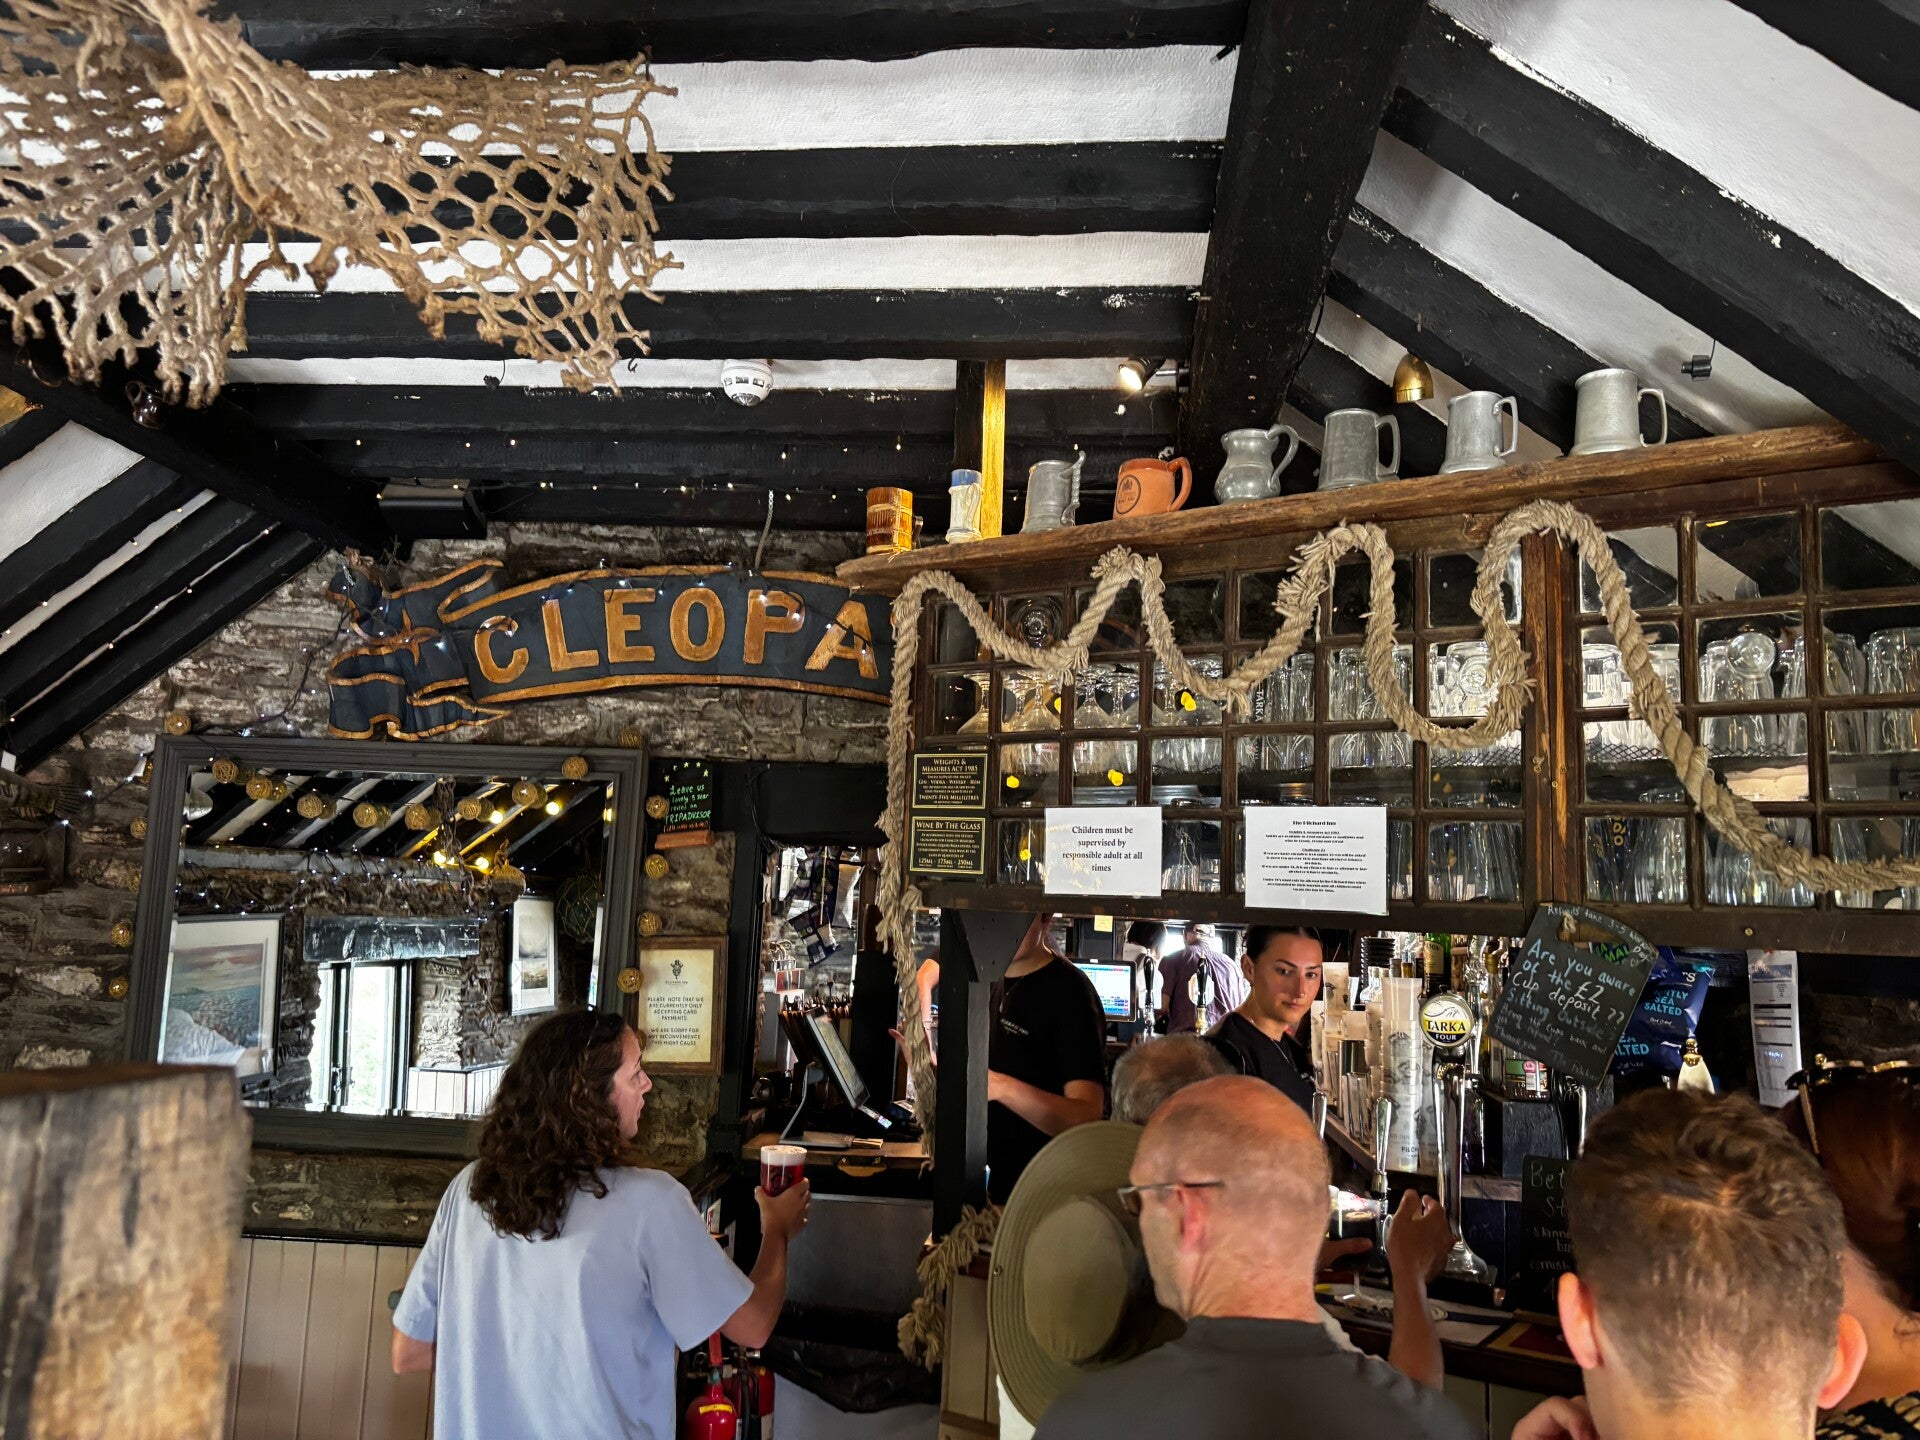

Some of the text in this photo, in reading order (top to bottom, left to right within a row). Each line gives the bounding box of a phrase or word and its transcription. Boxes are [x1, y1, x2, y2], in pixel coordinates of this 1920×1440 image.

[474, 587, 880, 684] CLEOPA
[670, 784, 705, 796] Leave us
[665, 810, 712, 824] TRIPADVISOR
[916, 821, 981, 830] WINE BY THE GLASS
[1072, 826, 1134, 834] Children must be
[1078, 839, 1127, 848] supervised by
[1062, 852, 1102, 860] responsible
[1133, 851, 1143, 859] all
[1092, 864, 1112, 872] times
[1527, 937, 1637, 997] Are you aware
[1522, 959, 1607, 1005] of the £2
[1507, 988, 1550, 1023] Sitting
[1549, 985, 1602, 1020] deposit
[1654, 996, 1675, 1006] SEA
[1643, 1003, 1683, 1016] SALTED
[1425, 1019, 1467, 1033] TARKA
[1435, 1033, 1457, 1041] FOUR
[1614, 1044, 1650, 1056] ALTED
[1530, 1160, 1566, 1190] Bet
[1544, 1196, 1567, 1218] St
